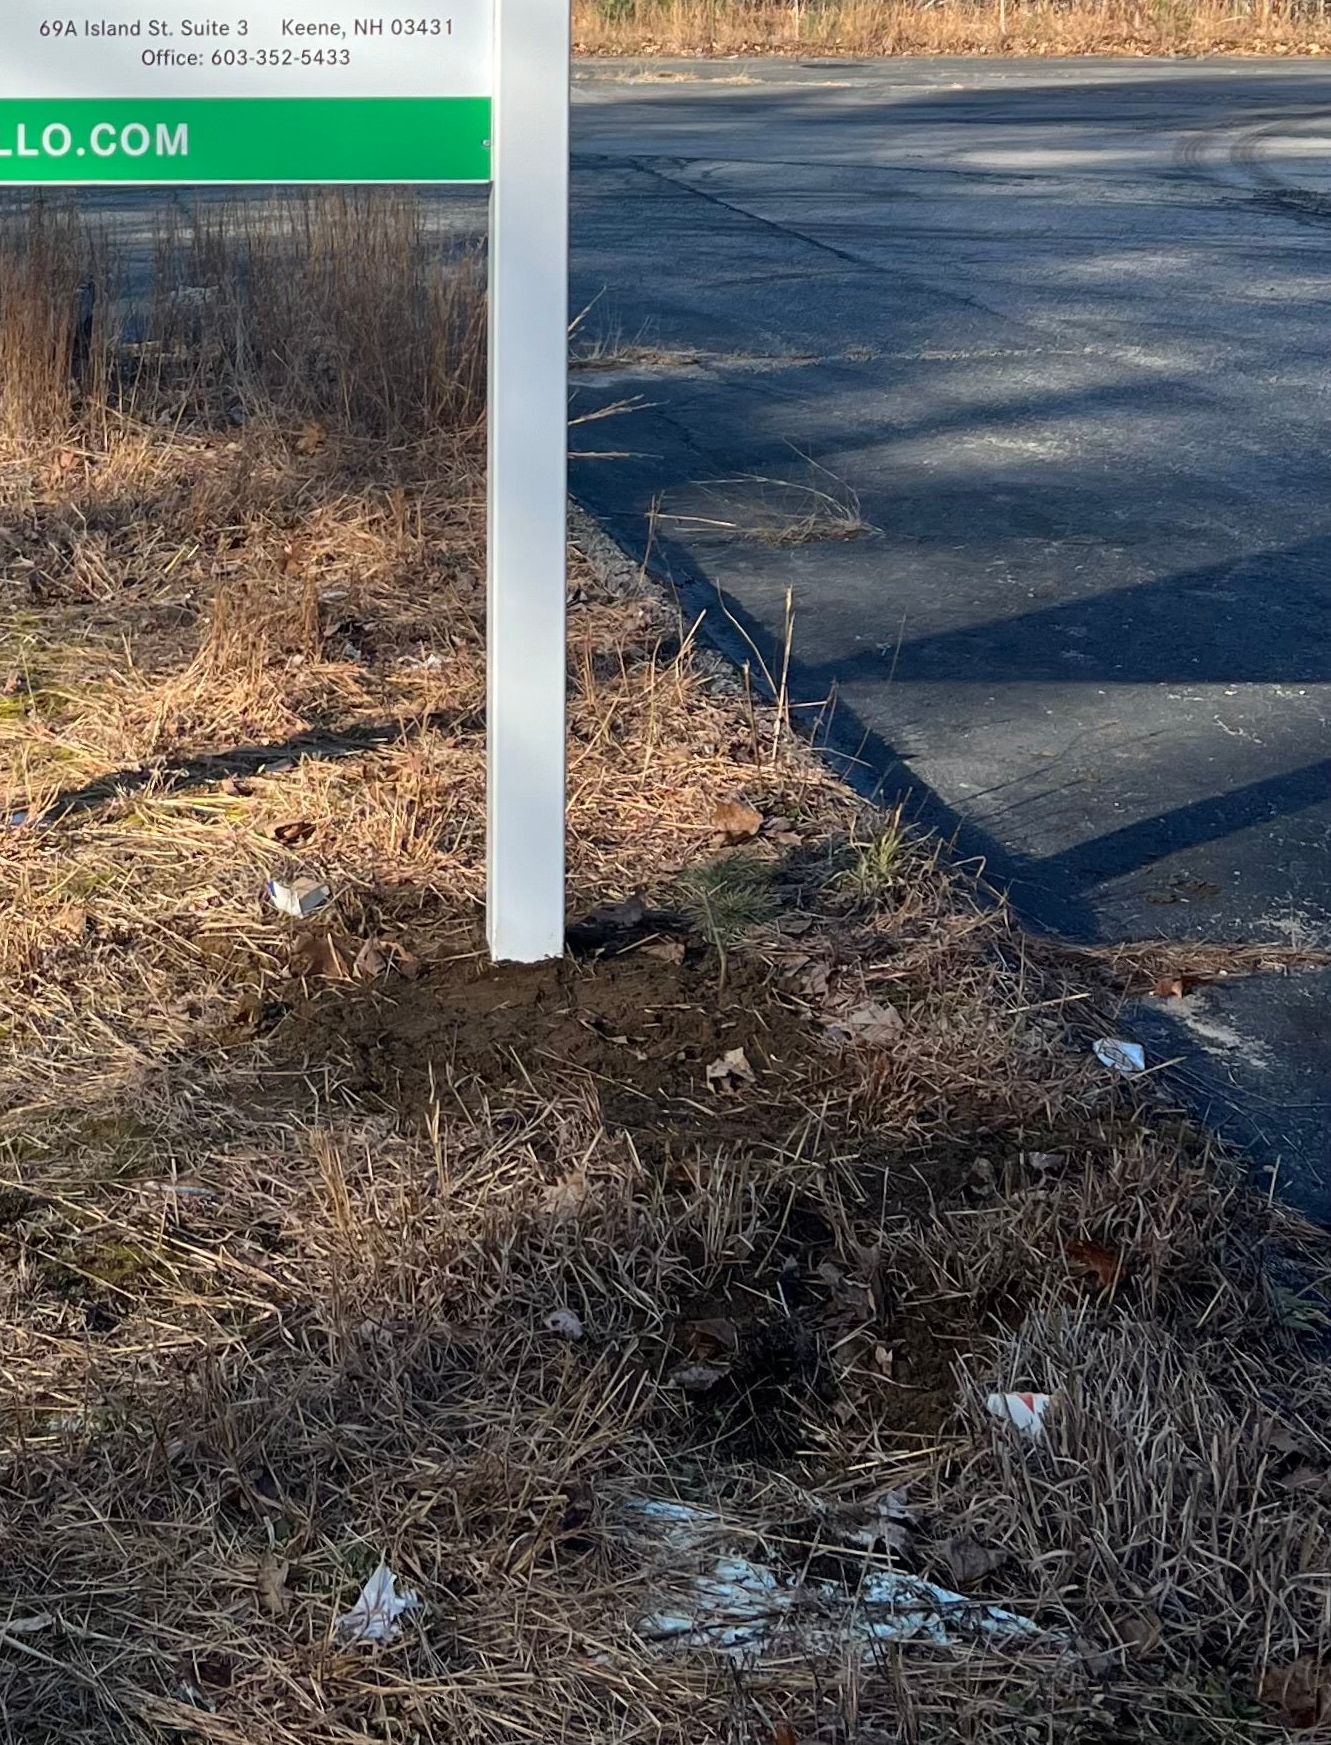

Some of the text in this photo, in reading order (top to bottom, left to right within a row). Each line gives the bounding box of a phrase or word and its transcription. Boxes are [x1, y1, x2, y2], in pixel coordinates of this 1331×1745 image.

[39, 18, 452, 39] 69A Island St. Suite 3 Keene, NH 03431
[141, 48, 350, 66] Office: 603-352-5433
